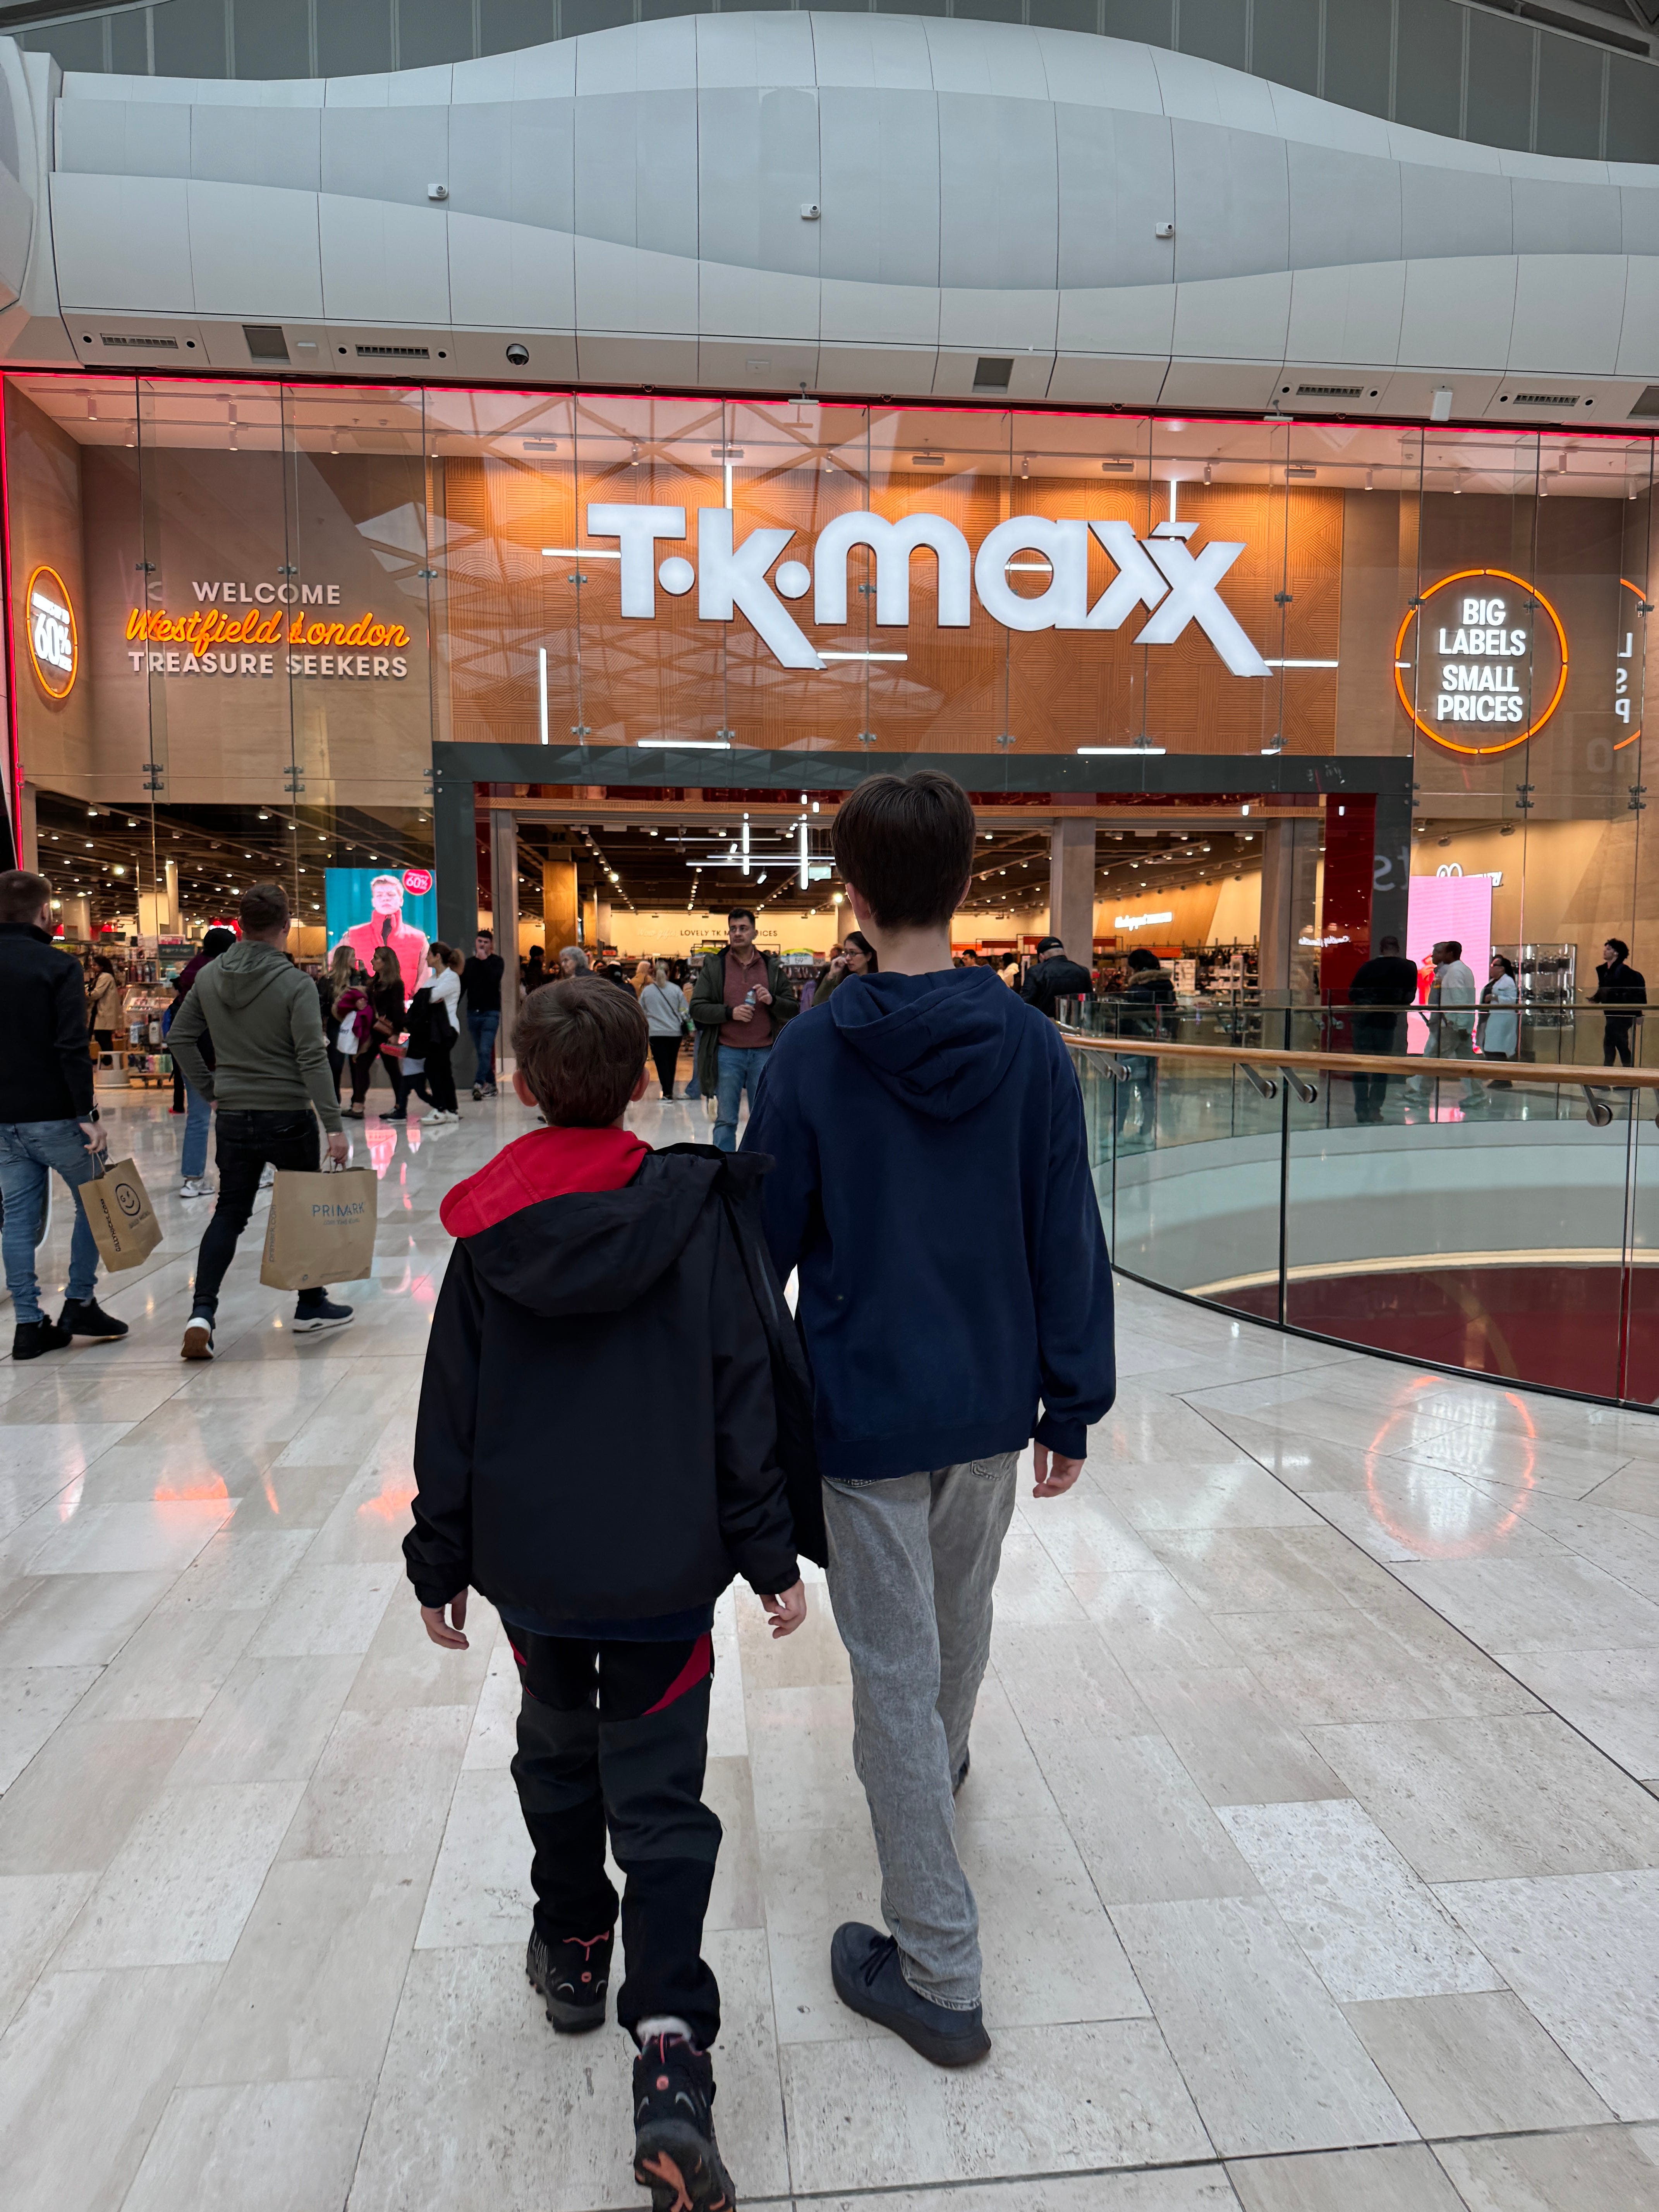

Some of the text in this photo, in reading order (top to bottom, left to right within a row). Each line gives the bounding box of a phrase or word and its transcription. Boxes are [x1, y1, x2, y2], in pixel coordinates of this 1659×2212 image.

[193, 582, 340, 605] WELCOME
[1462, 599, 1506, 625] BIG
[34, 613, 72, 665] 60%
[126, 608, 410, 658] Westfield London
[1439, 628, 1526, 656] LABELS
[128, 651, 408, 677] TREASURE SEEKERS
[1441, 665, 1519, 692] SMALL
[1437, 695, 1523, 722] PRICES
[405, 876, 428, 889] 60%
[312, 1202, 364, 1216] PRIMARK
